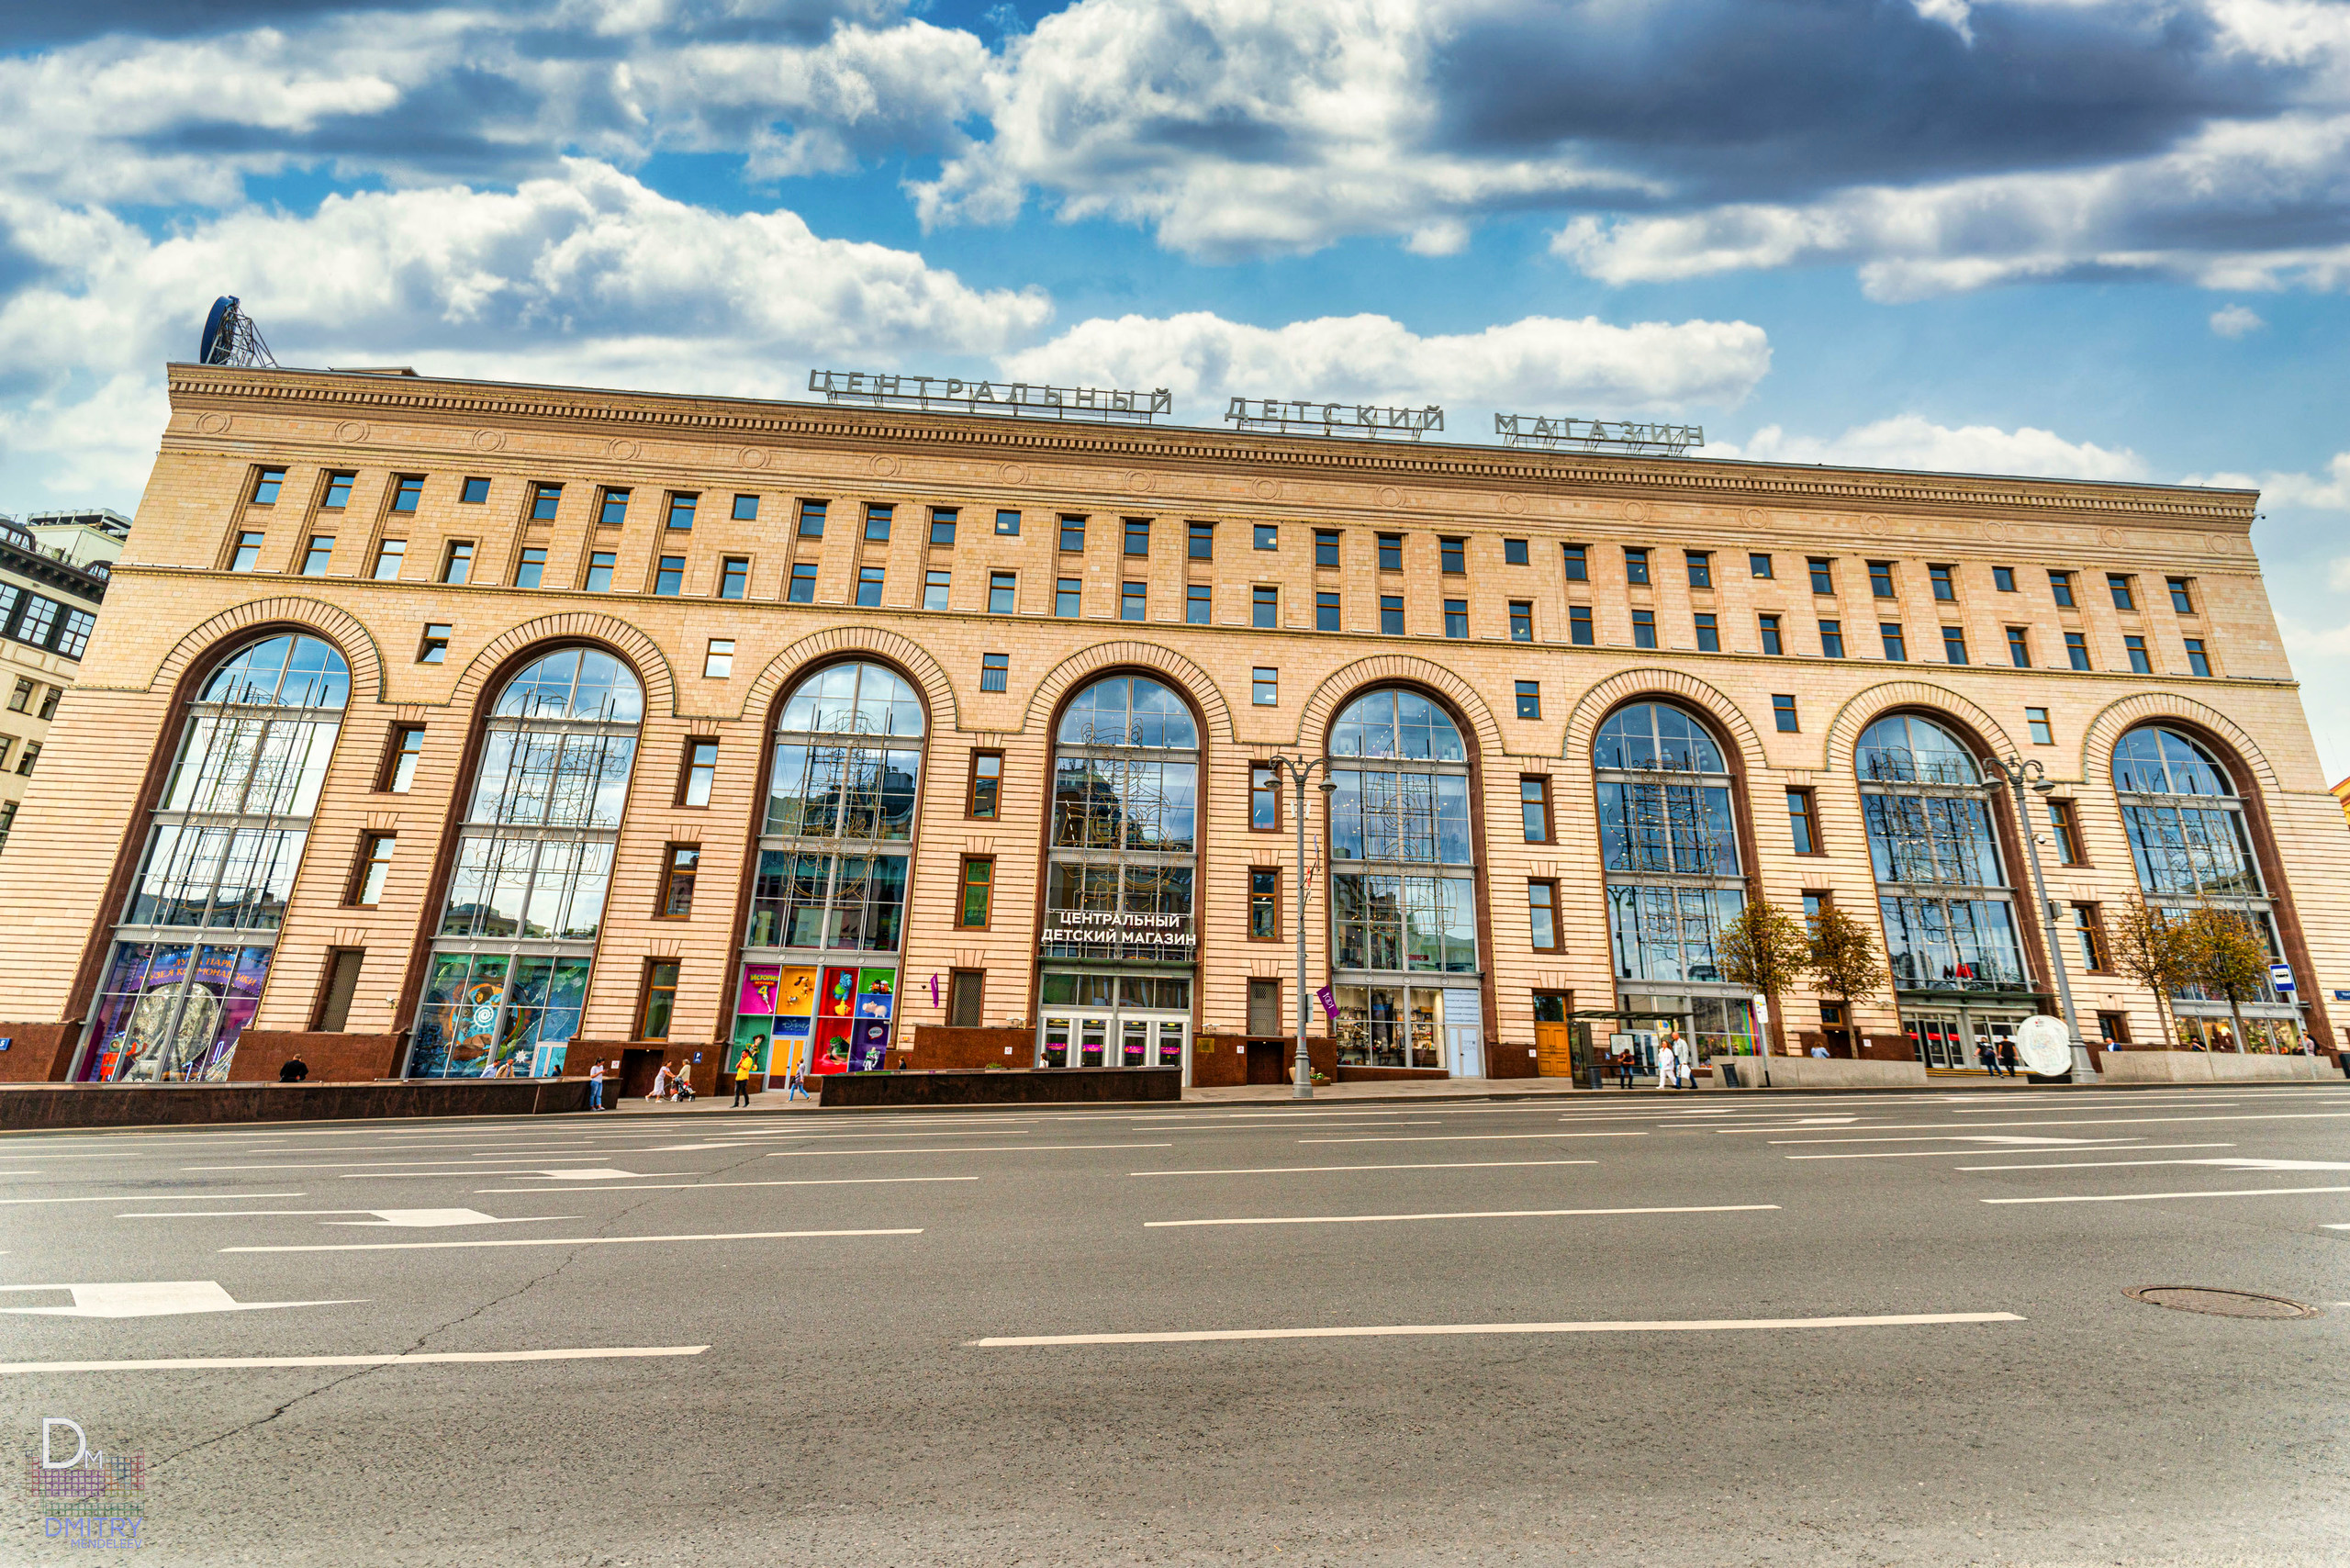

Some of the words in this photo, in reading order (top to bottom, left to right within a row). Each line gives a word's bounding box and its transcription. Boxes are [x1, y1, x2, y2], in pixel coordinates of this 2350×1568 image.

[809, 369, 1172, 415] ЦЕНТРАЛЬНЫЙ
[1225, 397, 1445, 431] ДЕТСКИЙ
[1494, 412, 1705, 447] МАГАЗИН
[1060, 912, 1181, 928] ЦЕНТРАЛЬНЫЙ
[1041, 928, 1116, 943] ДЕТСКИЙ
[1121, 931, 1196, 946] МАГАЗИН
[206, 958, 234, 969] ПАРК
[1956, 962, 1974, 978] М
[176, 968, 257, 986] КМОНАТИКИ
[757, 985, 768, 995] 4
